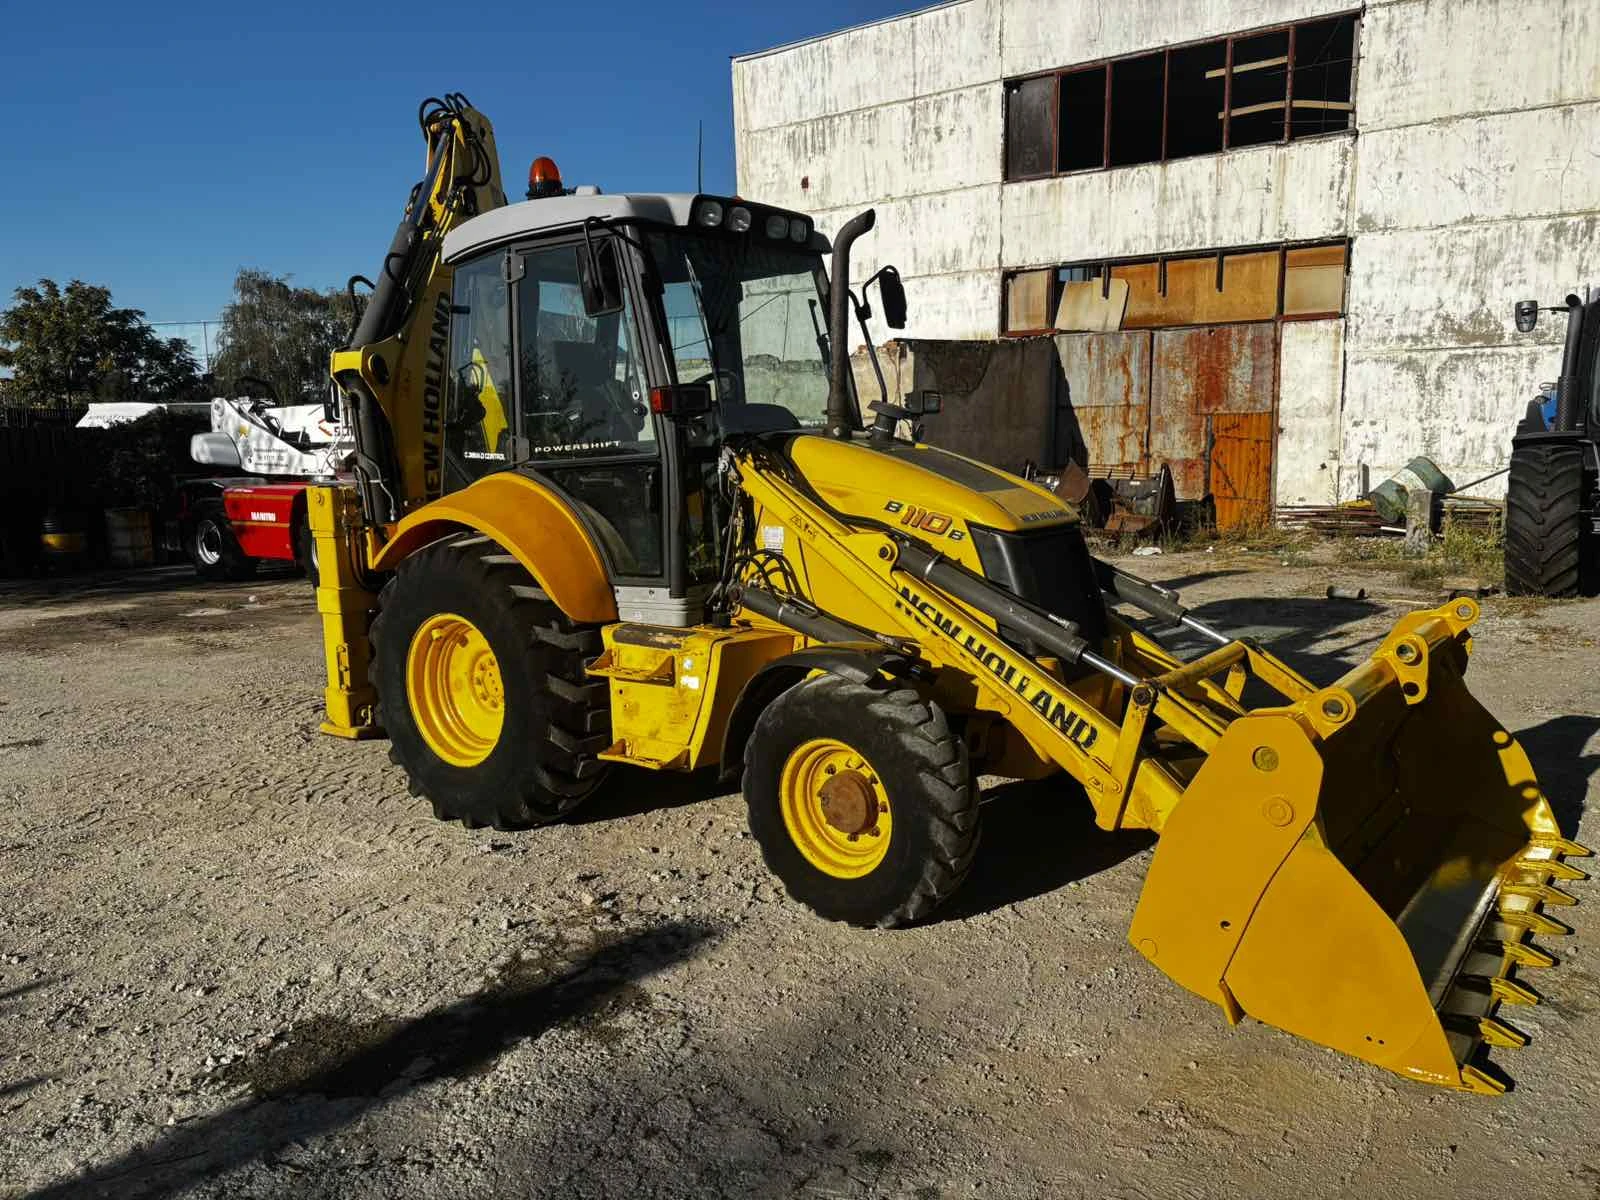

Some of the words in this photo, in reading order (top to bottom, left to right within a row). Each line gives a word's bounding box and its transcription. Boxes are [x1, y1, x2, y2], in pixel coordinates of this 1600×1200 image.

[423, 291, 450, 433] HOLLAND
[534, 440, 622, 453] POWERSHIFT
[884, 500, 903, 513] B
[901, 504, 952, 536] 110
[960, 635, 1099, 751] HOLLAND
